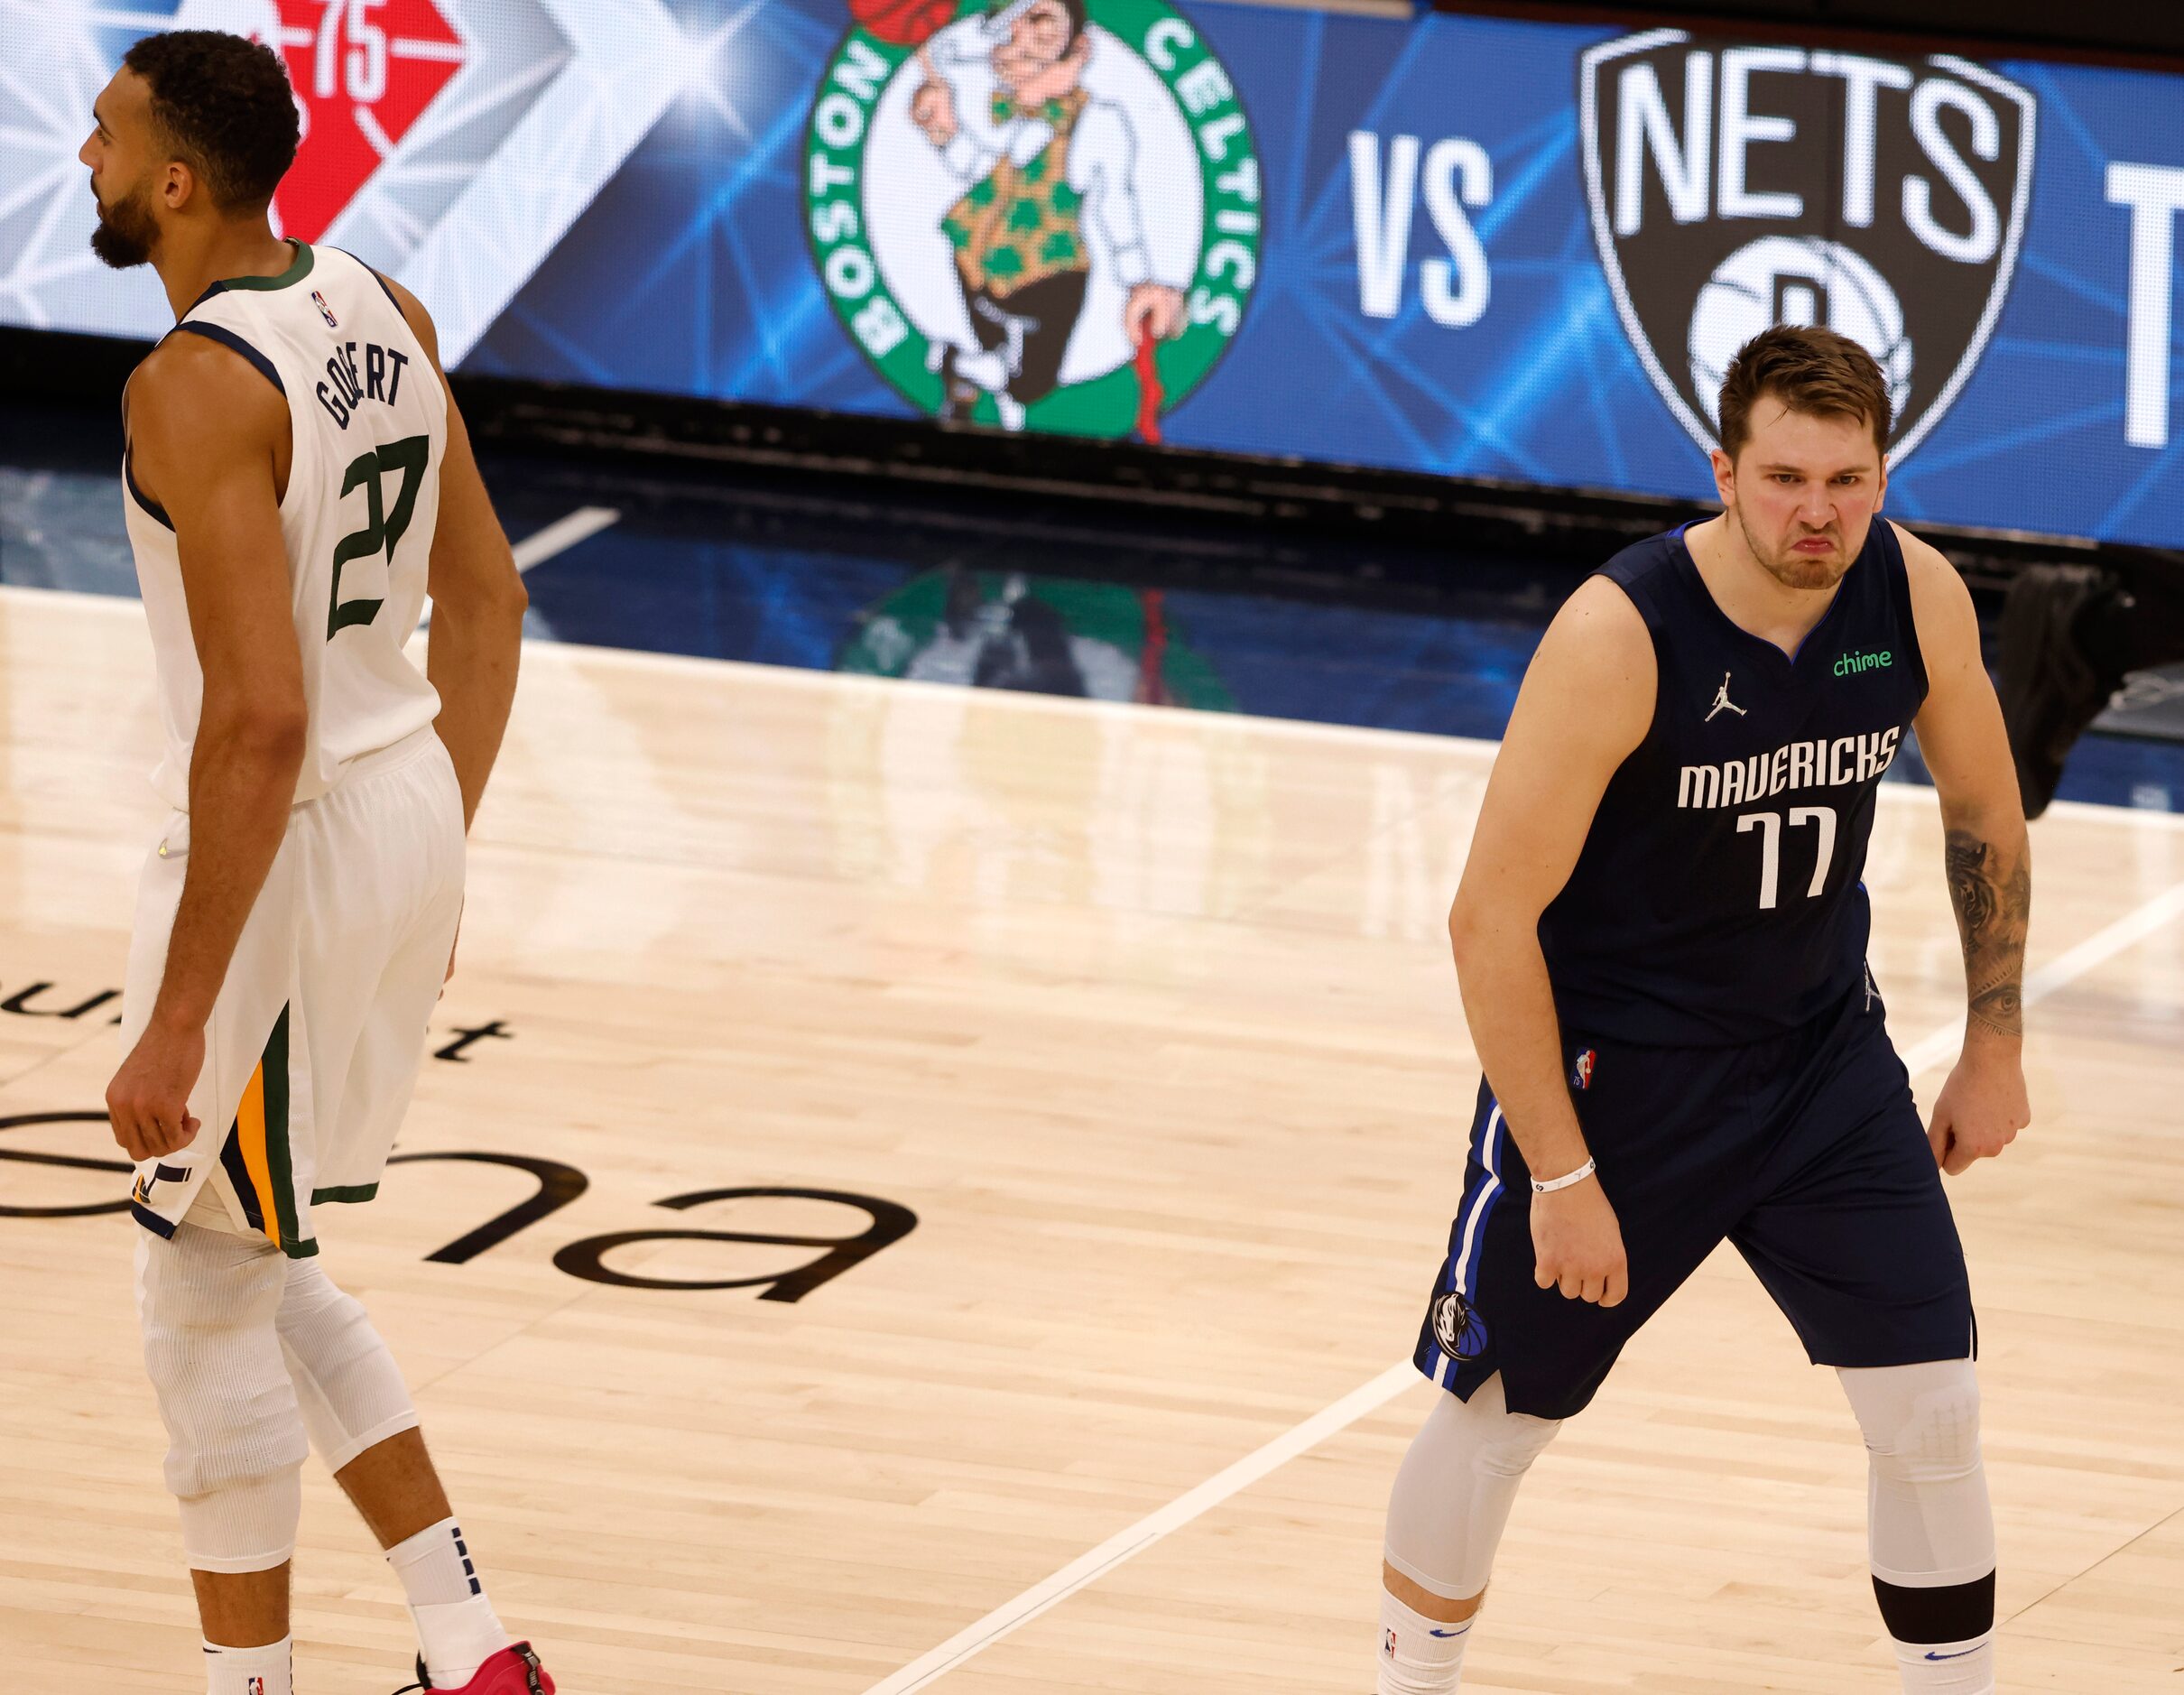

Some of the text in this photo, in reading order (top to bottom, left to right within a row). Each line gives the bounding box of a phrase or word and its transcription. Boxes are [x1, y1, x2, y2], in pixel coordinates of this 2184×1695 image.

[312, 0, 387, 102] 75
[813, 17, 1259, 358] BOSTON CELTICS
[1346, 130, 1494, 329] VS
[1615, 47, 2000, 264] NETS
[327, 435, 429, 643] 27
[1834, 651, 1892, 676] chime
[1678, 726, 1900, 809] MAVERICKS
[1736, 806, 1837, 910] 77
